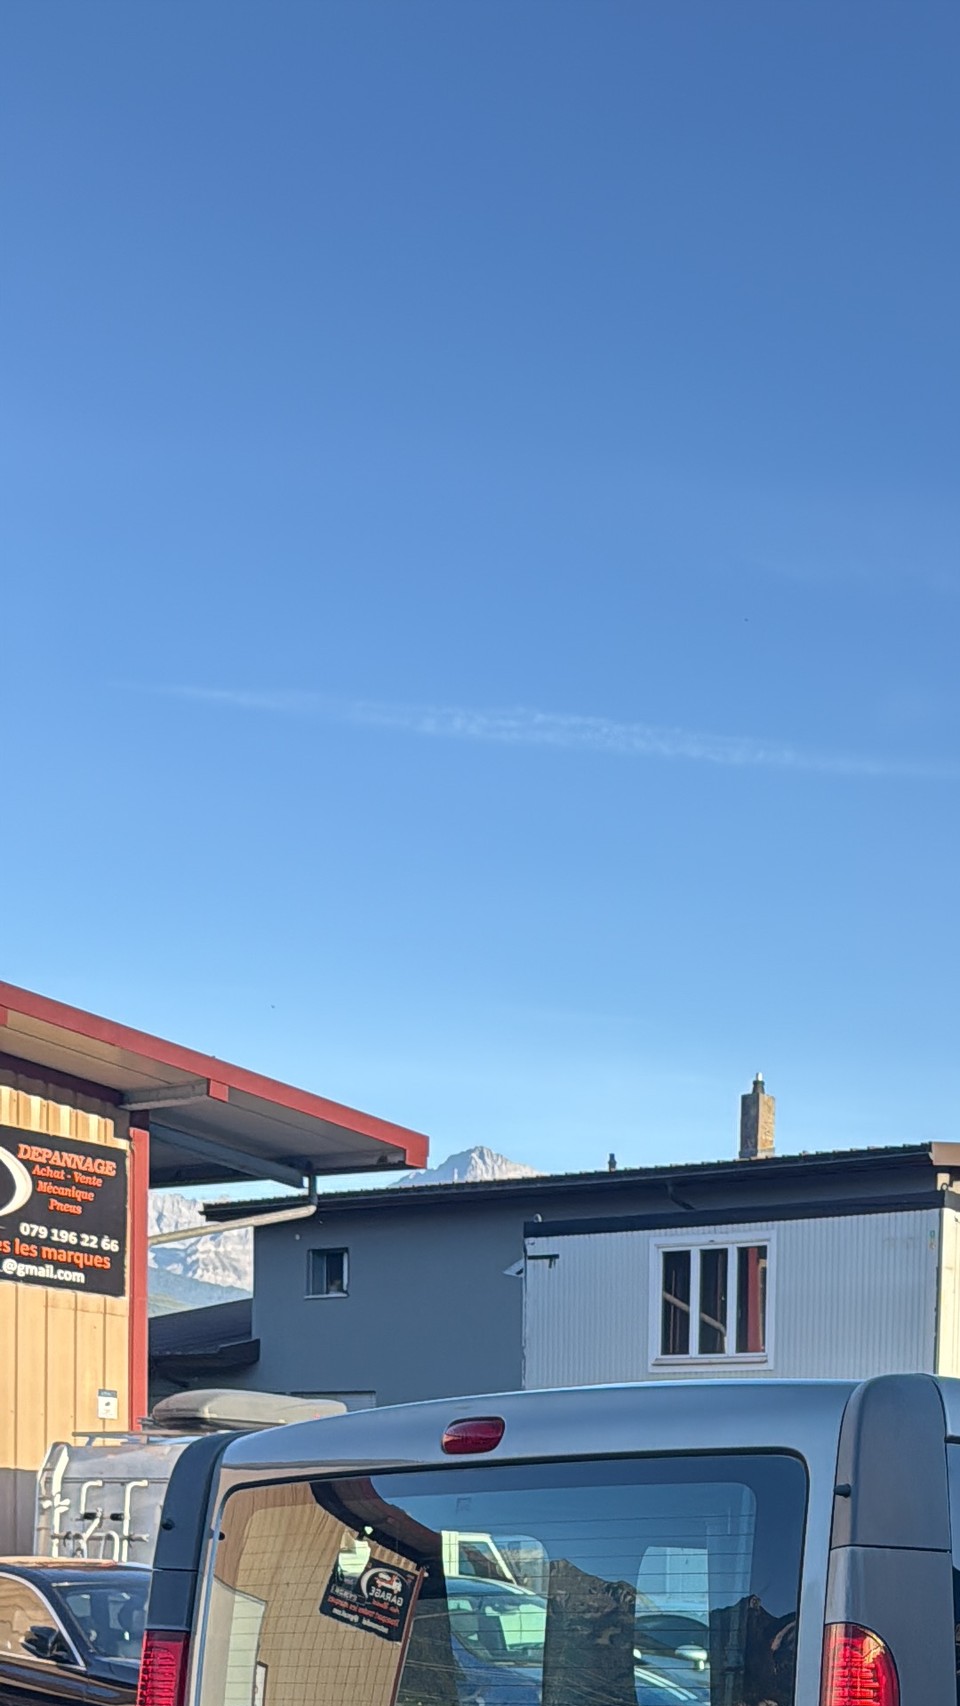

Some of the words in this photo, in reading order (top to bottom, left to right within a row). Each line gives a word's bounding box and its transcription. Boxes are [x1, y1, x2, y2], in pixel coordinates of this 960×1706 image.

[17, 1143, 117, 1177] DEPANNAGE
[32, 1164, 65, 1180] Achat
[73, 1171, 103, 1187] Vente
[36, 1180, 95, 1202] Mécanique
[48, 1197, 83, 1215] Pneus
[19, 1222, 48, 1239] 079
[50, 1228, 78, 1245] 196
[80, 1233, 99, 1249] 22
[100, 1236, 120, 1252] 66
[0, 1239, 11, 1254] s
[14, 1237, 38, 1258] les
[41, 1245, 111, 1270] marques
[0, 1257, 86, 1284] @gmail.com
